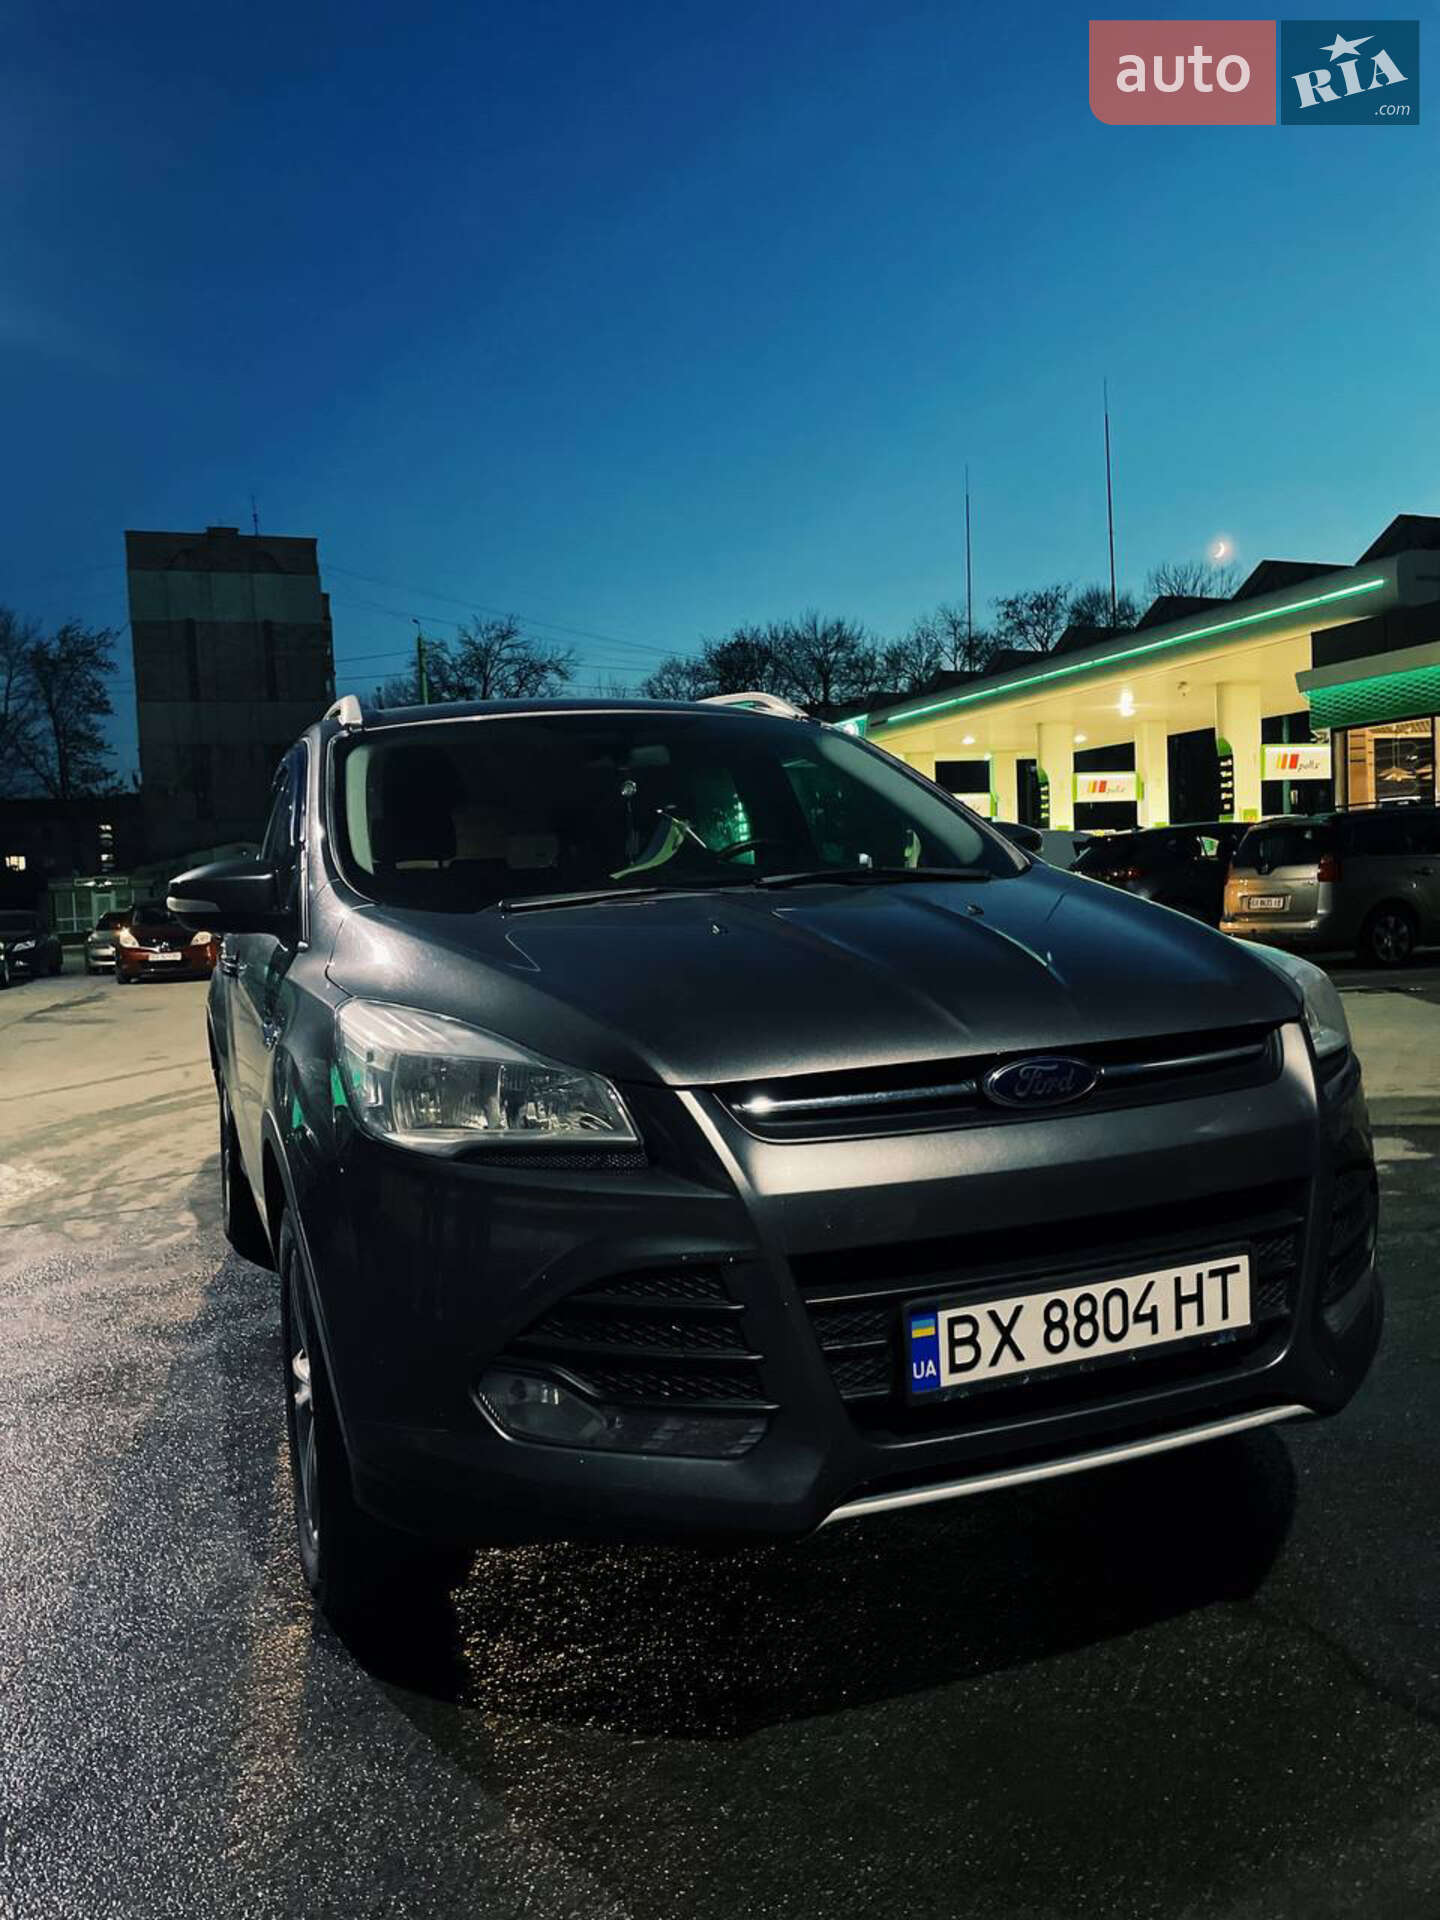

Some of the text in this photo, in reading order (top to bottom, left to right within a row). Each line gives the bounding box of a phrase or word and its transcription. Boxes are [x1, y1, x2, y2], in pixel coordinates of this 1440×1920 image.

[1015, 1063, 1075, 1098] Ford
[947, 1264, 1241, 1374] BX 8804 HT
[913, 1360, 937, 1379] UA
